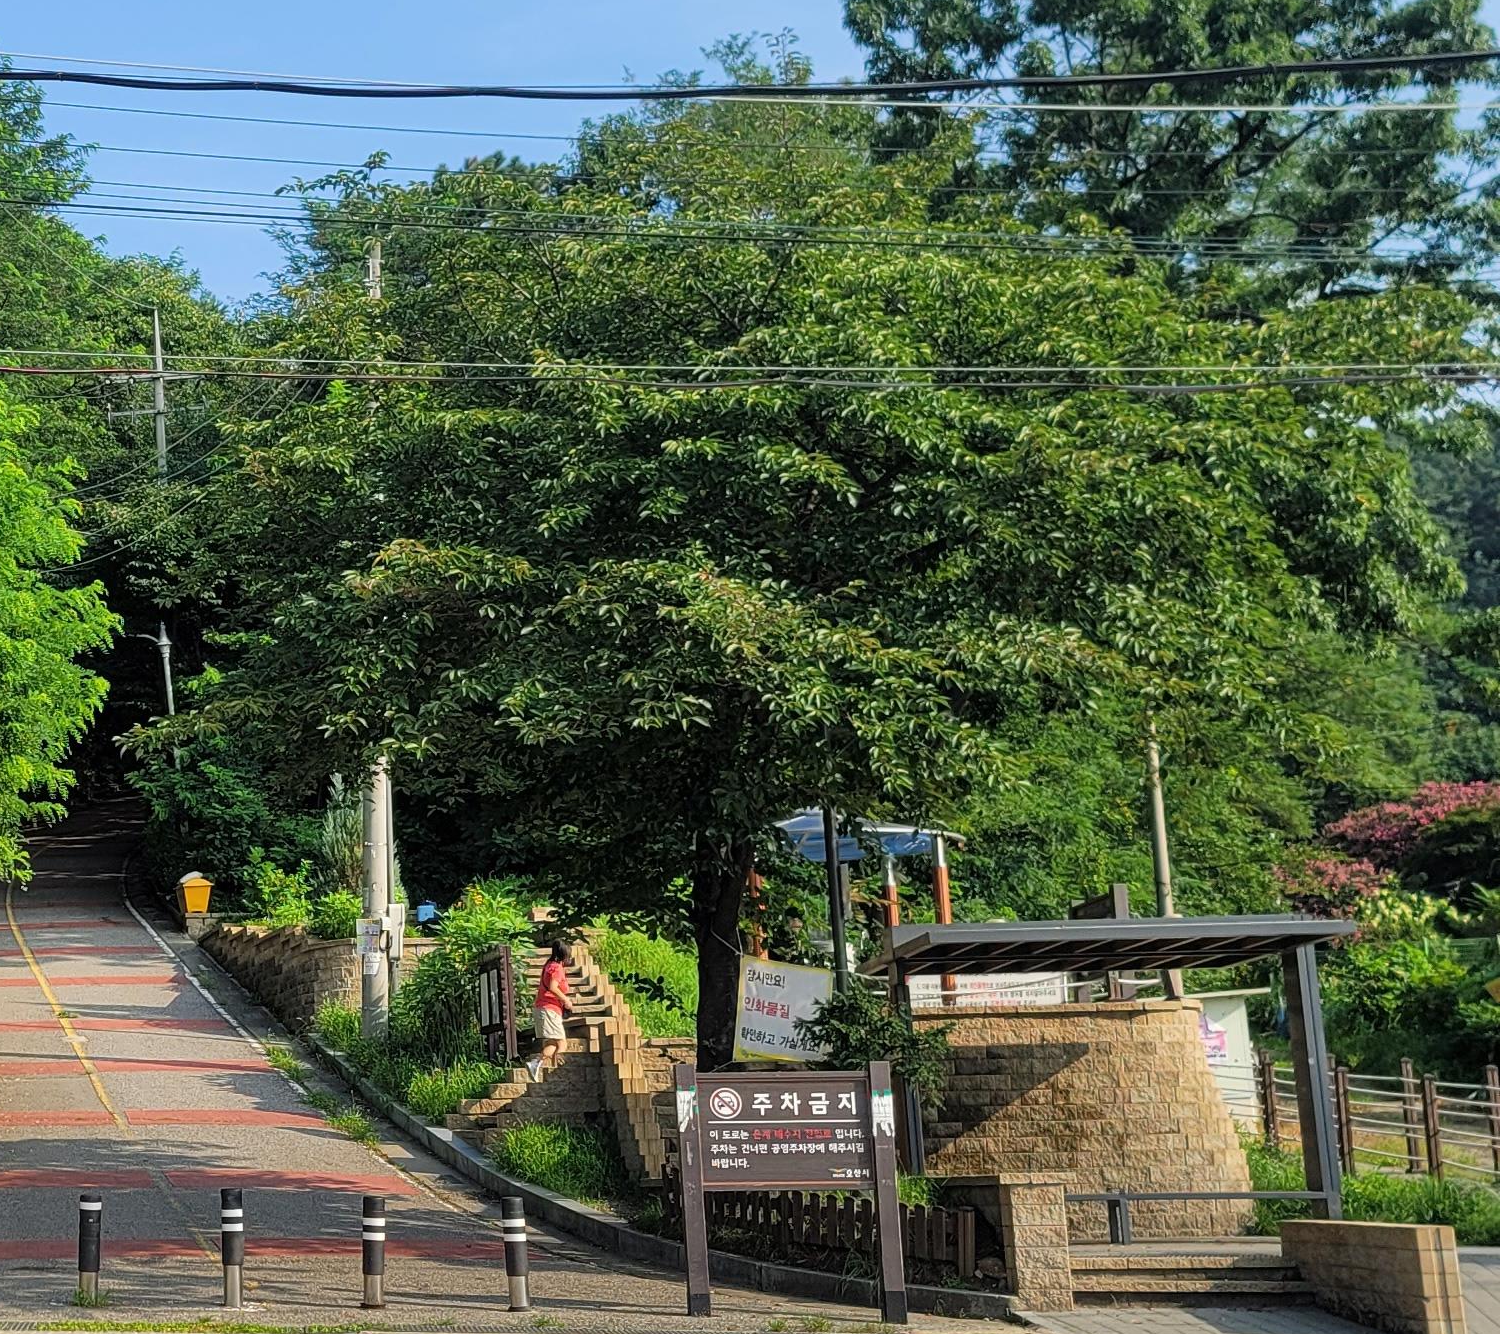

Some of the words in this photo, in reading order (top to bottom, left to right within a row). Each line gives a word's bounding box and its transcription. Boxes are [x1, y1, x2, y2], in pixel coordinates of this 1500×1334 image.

[747, 969, 786, 989] 잠시만요!
[744, 996, 790, 1020] 인화물질
[741, 1026, 776, 1046] 확인하고
[751, 1092, 858, 1117] 주차금지
[709, 1130, 719, 1141] 이
[722, 1130, 750, 1140] 도로는
[835, 1128, 865, 1140] 입니다.
[710, 1144, 738, 1155] 주차는
[741, 1144, 768, 1155] 건너편
[711, 1158, 750, 1169] 바랍니다.
